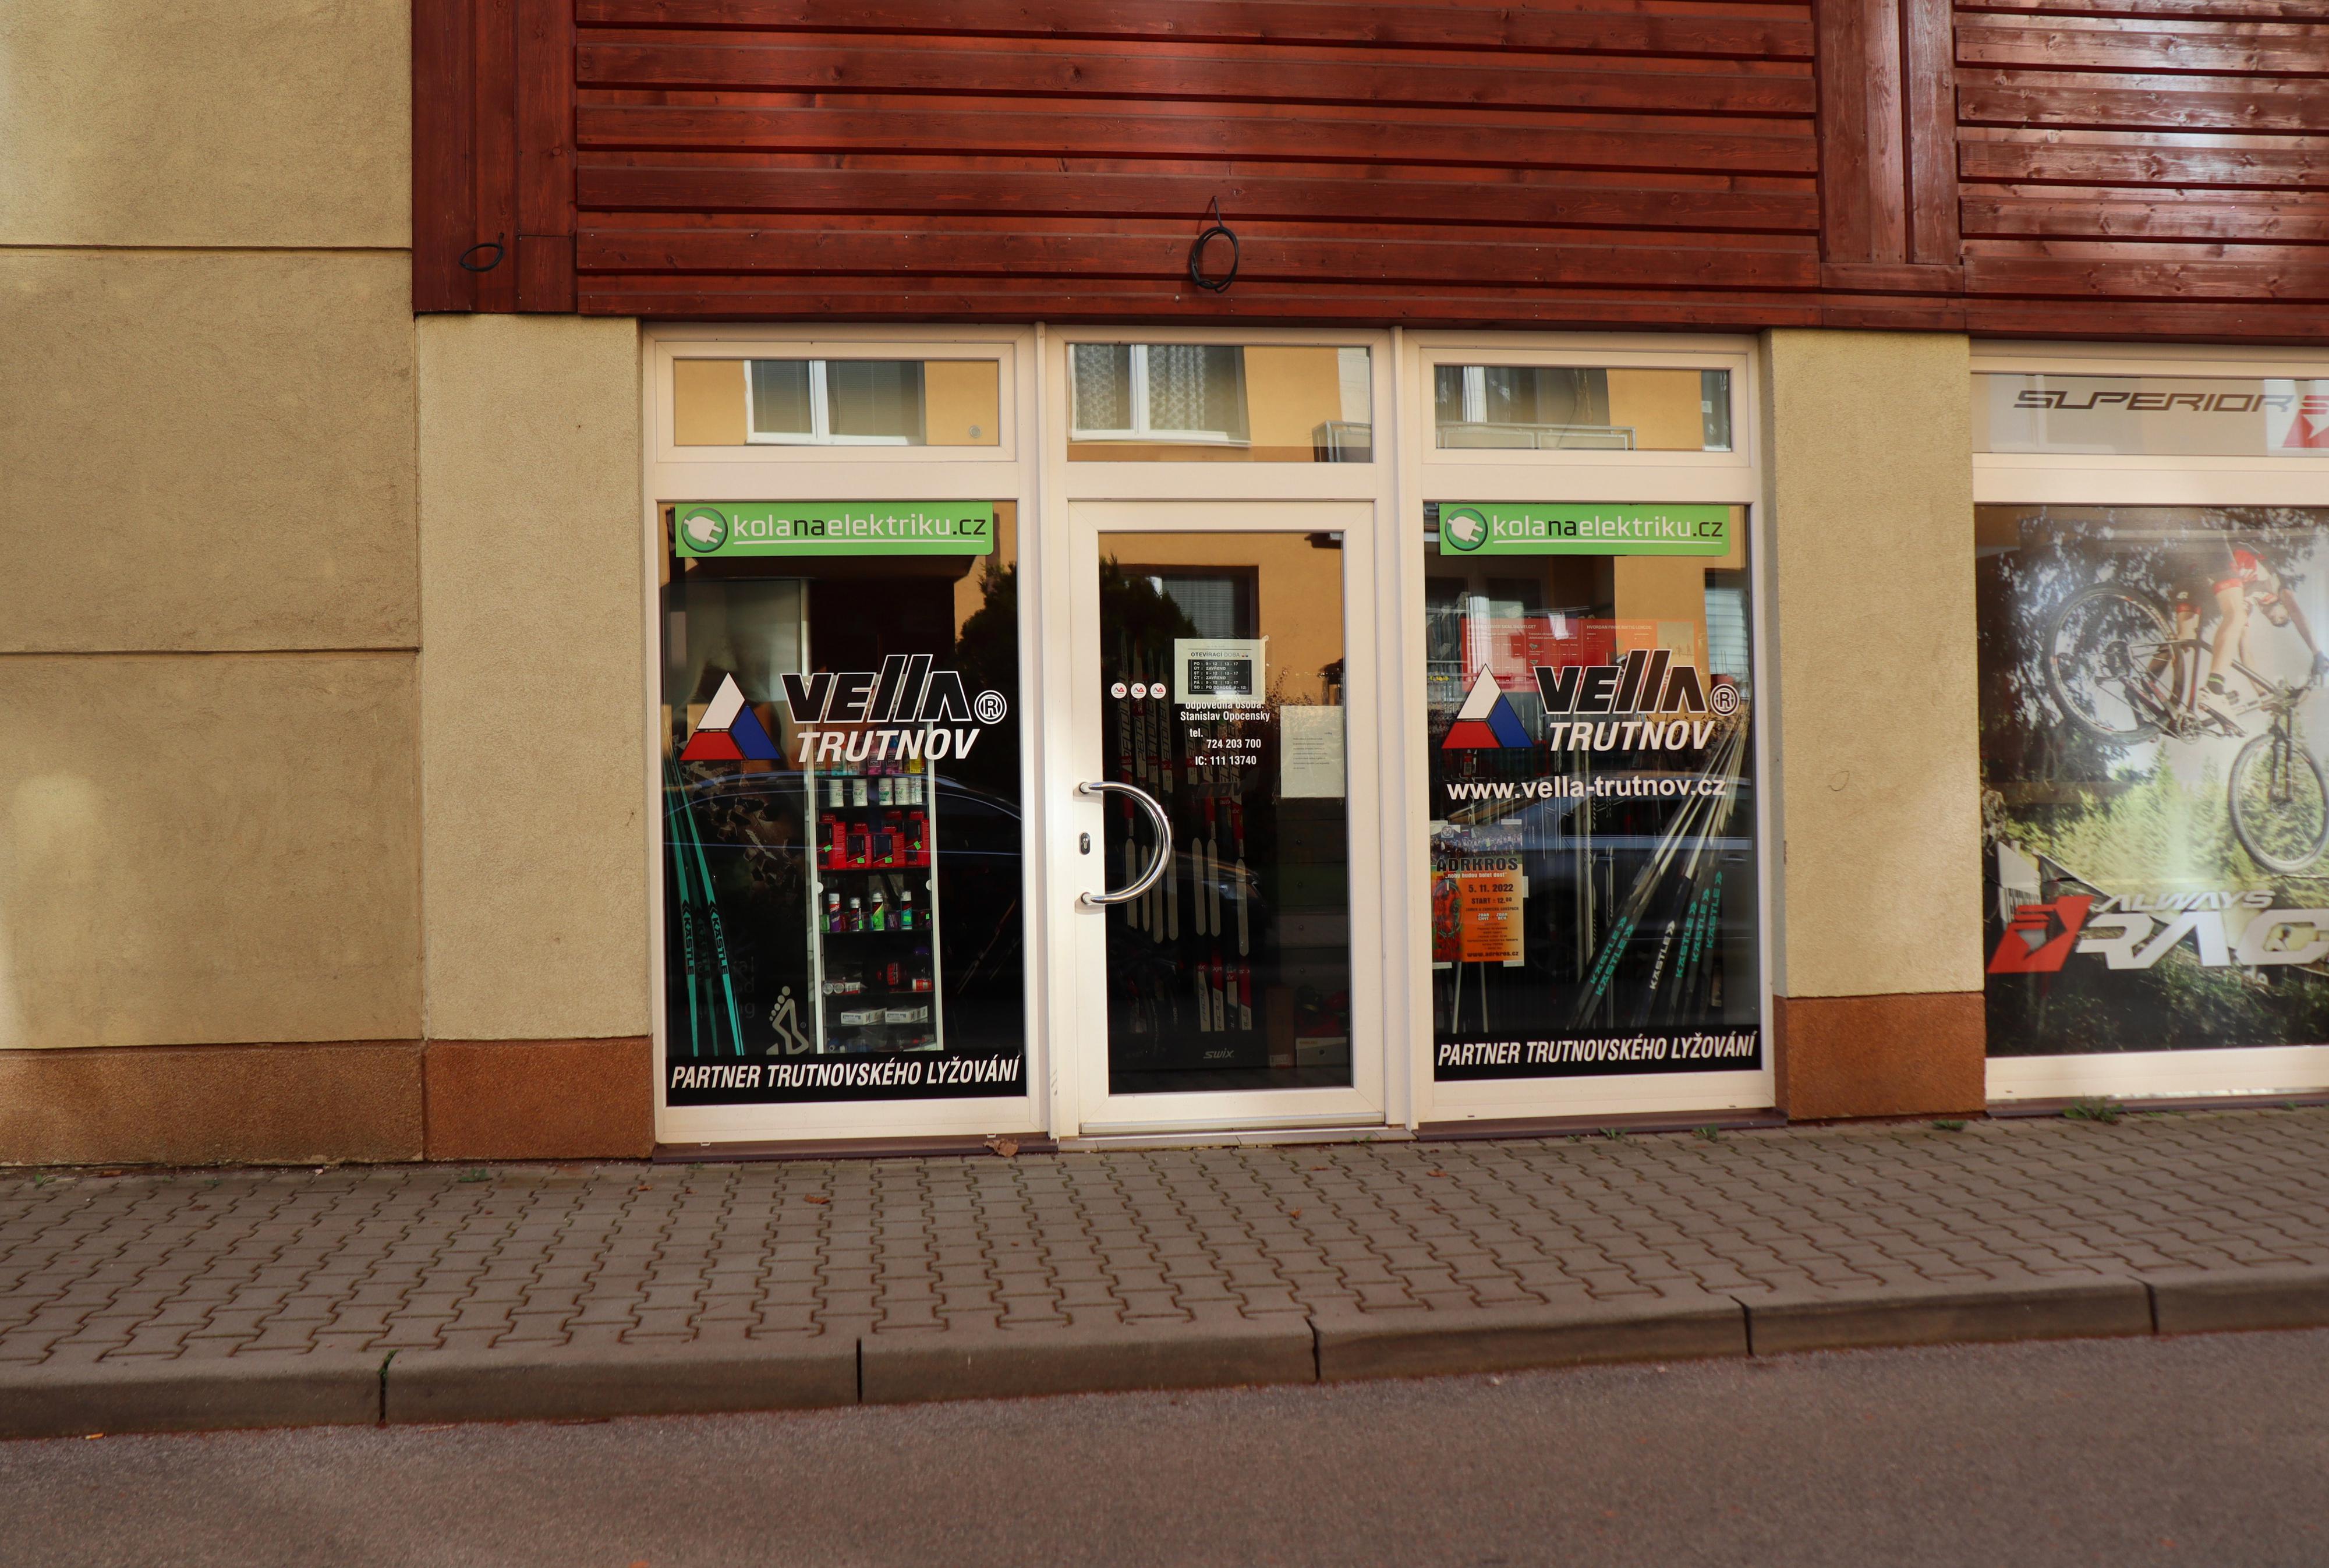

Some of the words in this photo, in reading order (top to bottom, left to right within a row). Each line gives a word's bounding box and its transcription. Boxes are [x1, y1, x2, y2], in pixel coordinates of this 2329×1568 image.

[2013, 390, 2294, 412] SUPERIOR
[734, 513, 986, 536] kolanaelektriku.cz
[1493, 515, 1723, 537] kolanaelektriku.cz
[1180, 711, 1220, 721] Stanislav
[1223, 711, 1270, 722] Opocensky
[1189, 728, 1204, 738] tel.
[1206, 739, 1223, 749] 724
[1226, 739, 1242, 749] 203
[1245, 739, 1261, 748] 700
[1549, 721, 1716, 752] TRUTNOV
[797, 728, 981, 763] TRUTNOV
[1195, 756, 1207, 766] IC:
[1210, 756, 1226, 765] 111
[1229, 755, 1256, 765] 13740
[1447, 776, 1727, 800] www.vella-trutnov.cz
[1468, 884, 1477, 893] 5.
[1479, 884, 1489, 893] 11.
[1493, 884, 1513, 892] 2022
[2096, 890, 2277, 912] ALWAYS
[1203, 1047, 1235, 1059] swix
[1438, 1042, 1520, 1066] PARTNER
[1526, 1034, 1668, 1063] TRUTNOVSKÉHO
[1670, 1031, 1758, 1060] LYŽOVÁNÍ
[671, 1066, 760, 1089] PARTNER
[767, 1057, 921, 1086] TRUTNOVSKÉHO
[926, 1053, 1021, 1084] LYŽOVÁNÍ
